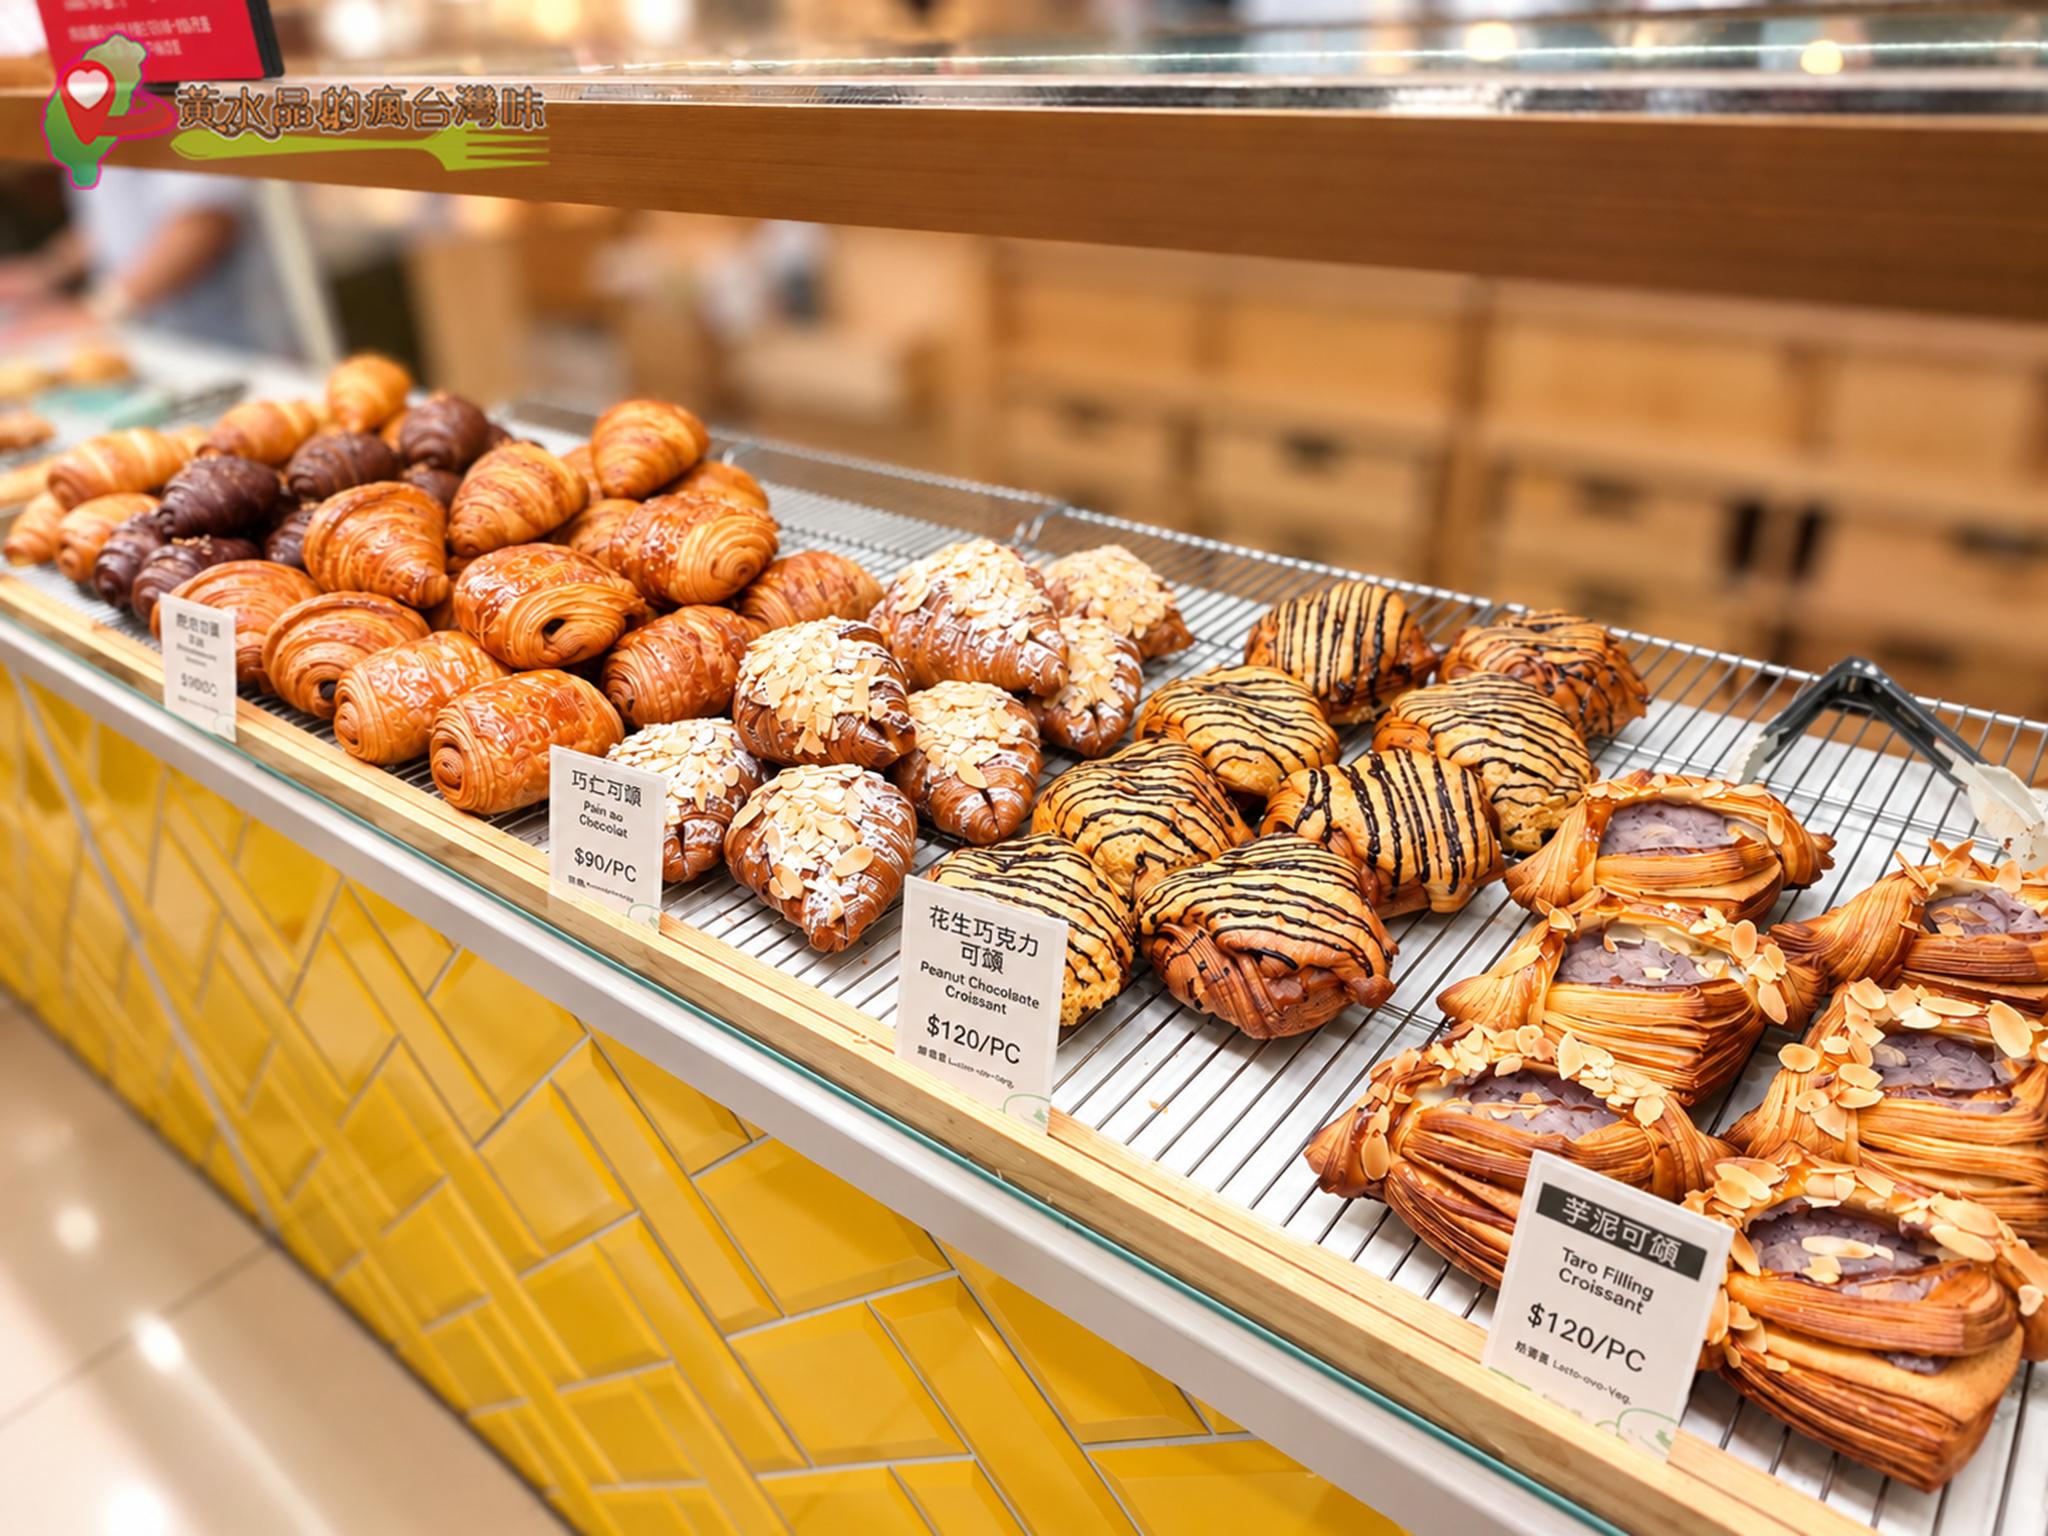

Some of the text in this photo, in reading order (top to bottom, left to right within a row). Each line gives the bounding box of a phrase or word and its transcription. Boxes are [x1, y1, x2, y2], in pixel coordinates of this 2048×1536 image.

[574, 847, 637, 884] $90/PC
[929, 904, 1040, 958] 花生巧克力
[919, 960, 967, 987] Peanut
[944, 984, 1008, 1016] Croissant
[926, 1013, 1022, 1066] $120/PC
[1561, 1196, 1683, 1269] 芋泥可頌
[1558, 1267, 1645, 1315] Croissant
[1561, 1246, 1655, 1302] Taro Filling
[1527, 1302, 1647, 1373] $120/PC
